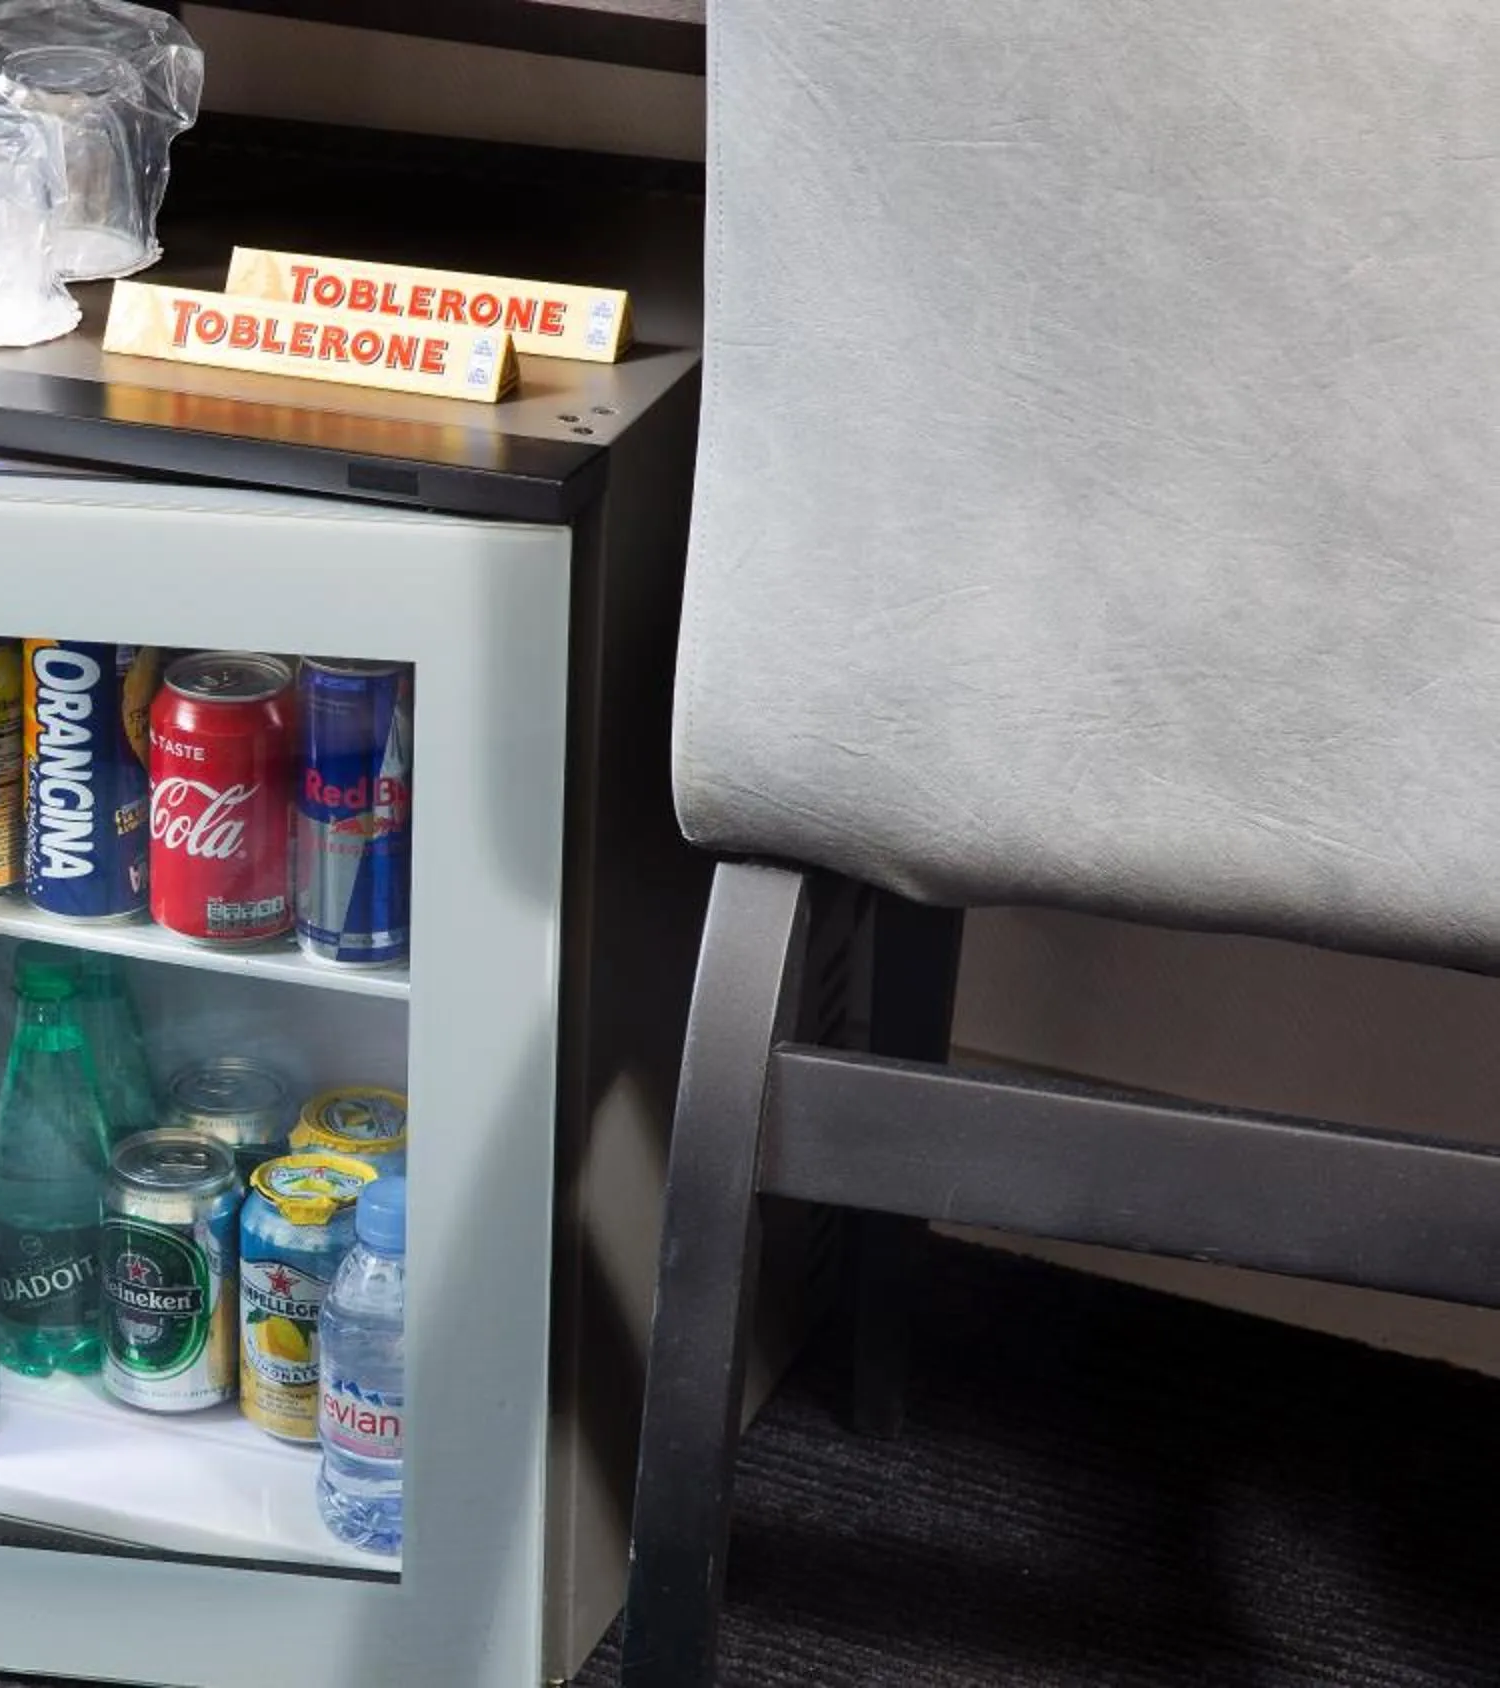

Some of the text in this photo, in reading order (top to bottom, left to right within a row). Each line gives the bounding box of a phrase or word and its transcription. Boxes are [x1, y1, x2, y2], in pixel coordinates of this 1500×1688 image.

[290, 265, 568, 338] TOBLERONE
[171, 299, 450, 375] TOBLERONE
[32, 647, 101, 879] ORANGINA
[158, 735, 205, 762] TASTE
[304, 767, 368, 810] Red
[150, 776, 261, 859] Cola
[0, 1254, 94, 1301] BADOIT
[105, 1280, 192, 1311] eineken
[323, 1393, 400, 1437] evian
